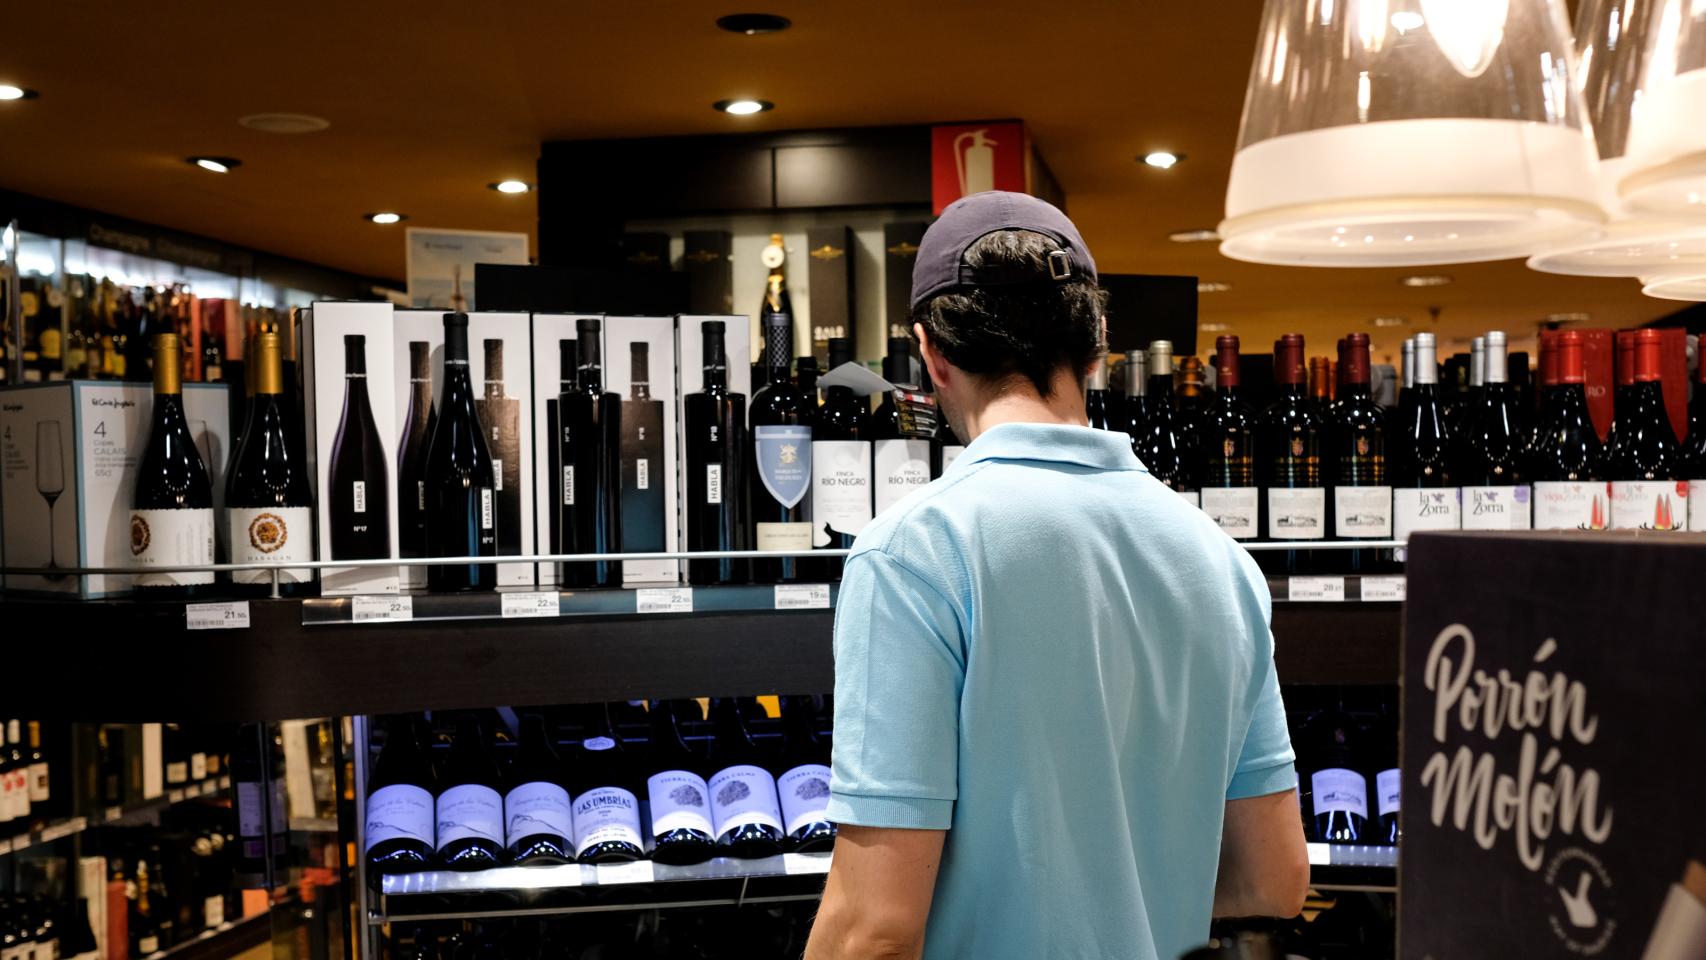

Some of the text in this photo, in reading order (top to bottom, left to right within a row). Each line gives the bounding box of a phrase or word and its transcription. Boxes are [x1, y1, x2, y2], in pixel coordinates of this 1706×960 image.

[94, 421, 107, 438] 4
[839, 477, 866, 486] NEGRO
[1420, 491, 1430, 505] la
[1473, 489, 1482, 503] la
[1418, 503, 1450, 517] Zorra
[1472, 501, 1504, 516] Zorra
[536, 599, 549, 607] 22
[671, 595, 682, 603] 22
[390, 603, 401, 611] 22
[224, 611, 235, 619] 21
[1424, 623, 1599, 743] Porrón
[578, 799, 592, 815] LAS
[592, 795, 632, 809] UMBRÍAS
[1420, 732, 1613, 872] Molón
